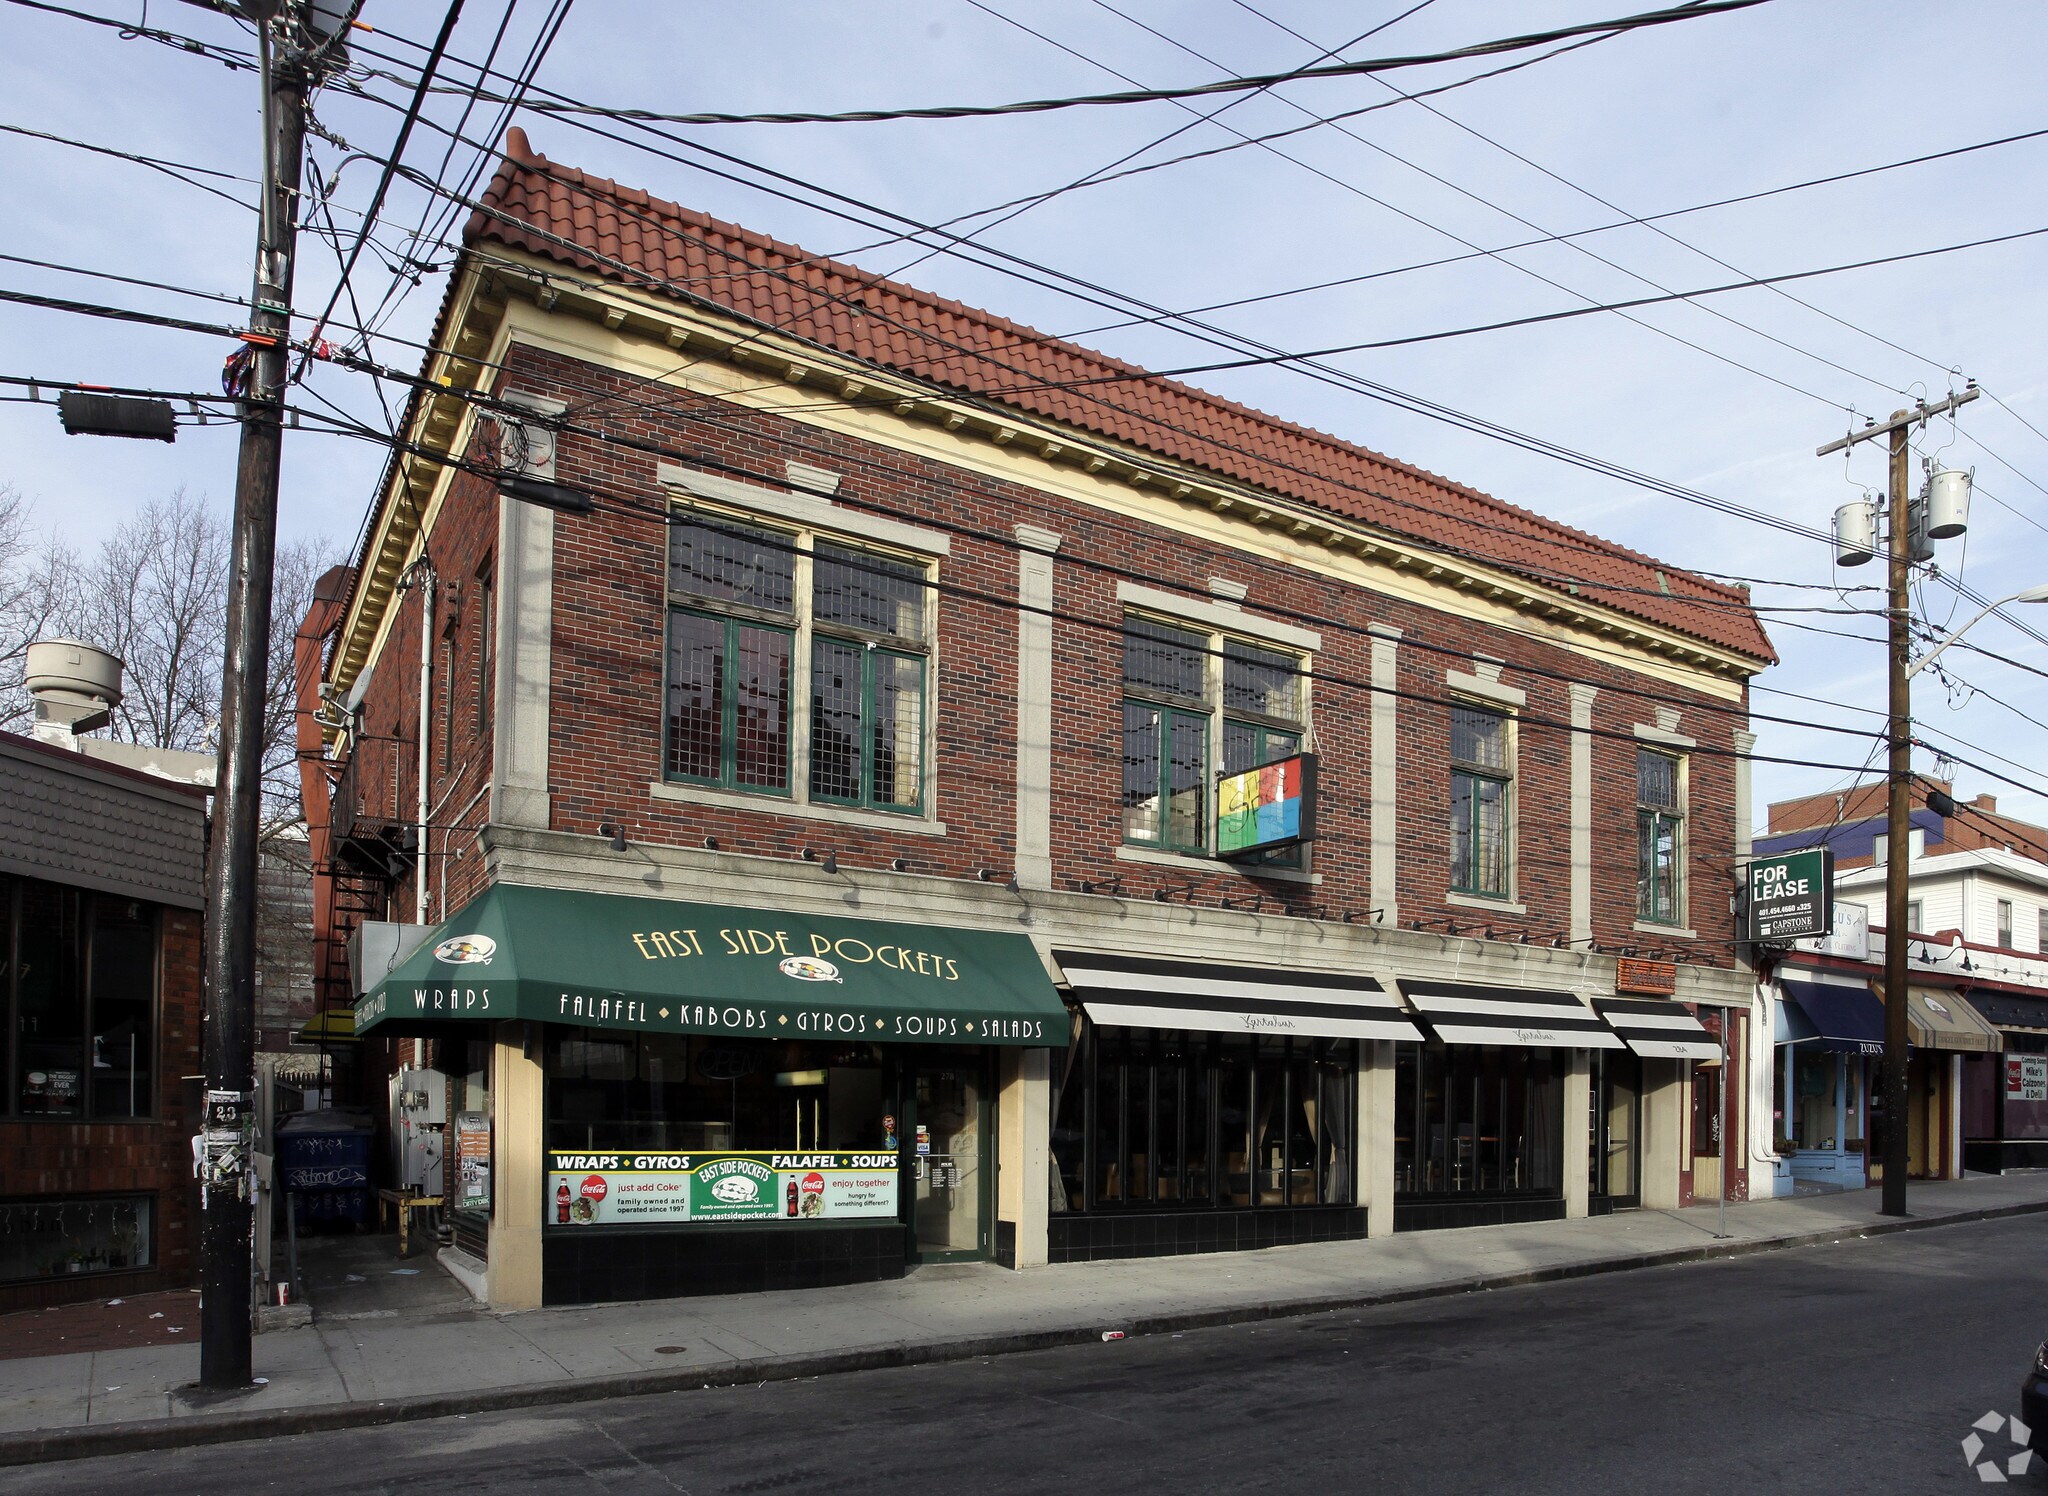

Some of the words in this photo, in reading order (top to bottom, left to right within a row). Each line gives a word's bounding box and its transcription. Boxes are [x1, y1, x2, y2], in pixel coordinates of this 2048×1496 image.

[1754, 865, 1787, 885] FOR
[1754, 879, 1809, 902] LEASE
[1758, 904, 1796, 916] 401.454.4660
[1797, 902, 1812, 911] x325
[1772, 916, 1813, 930] CAPSTONE
[631, 929, 705, 961] EAST
[719, 929, 794, 956] SIDE
[810, 933, 959, 981] POCKETS
[414, 988, 490, 1009] WRAPS
[559, 993, 647, 1022] FALAFEL
[680, 1004, 767, 1029] KABOBS
[797, 1011, 866, 1033] GYROS
[895, 1016, 957, 1036] SOUPS
[981, 1019, 1043, 1039] SALADS
[2021, 1057, 2036, 1065] Coming
[2025, 1067, 2042, 1077] Mike's
[2022, 1078, 2046, 1088] Calzones
[556, 1156, 619, 1169] WRAPS
[634, 1156, 690, 1169] GYROS
[771, 1155, 838, 1168] FALAFEL
[851, 1155, 897, 1168] SOUPS
[698, 1164, 720, 1183] EAST
[719, 1161, 737, 1175] SIDE
[737, 1161, 771, 1182] POCKETS
[617, 1184, 634, 1193] just
[636, 1183, 654, 1192] add
[832, 1180, 854, 1188] enjoy
[856, 1179, 890, 1188] together
[617, 1198, 641, 1206] family
[863, 1199, 889, 1207] different?
[617, 1205, 648, 1214] operated
[691, 1211, 783, 1221] www.eastsidepocket.com
